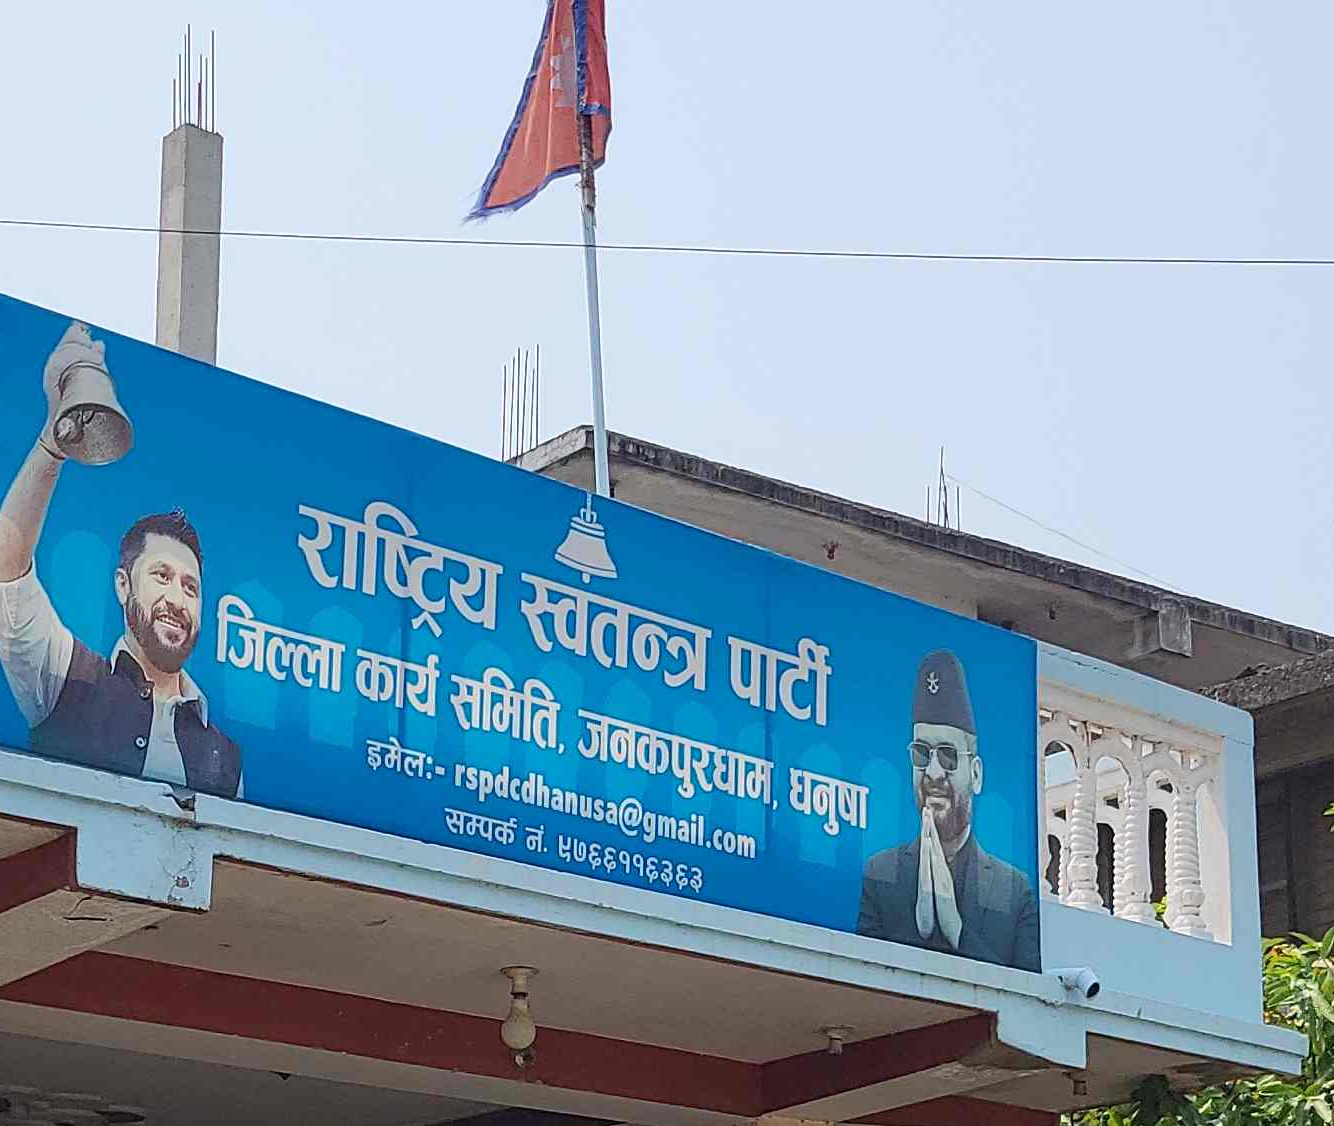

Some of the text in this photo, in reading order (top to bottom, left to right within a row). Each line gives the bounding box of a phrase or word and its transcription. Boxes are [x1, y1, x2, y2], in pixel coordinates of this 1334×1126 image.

[298, 501, 833, 726] राष्ट्रिय स्वतन्त्र पार्टी
[217, 594, 870, 836] जिल्ला कार्य समिति, जनकपुरधाम, धनुषा
[445, 808, 517, 846] सम्पर्क
[525, 825, 548, 853] नं.
[454, 763, 757, 860] rspdcdhanusa@gmail.com
